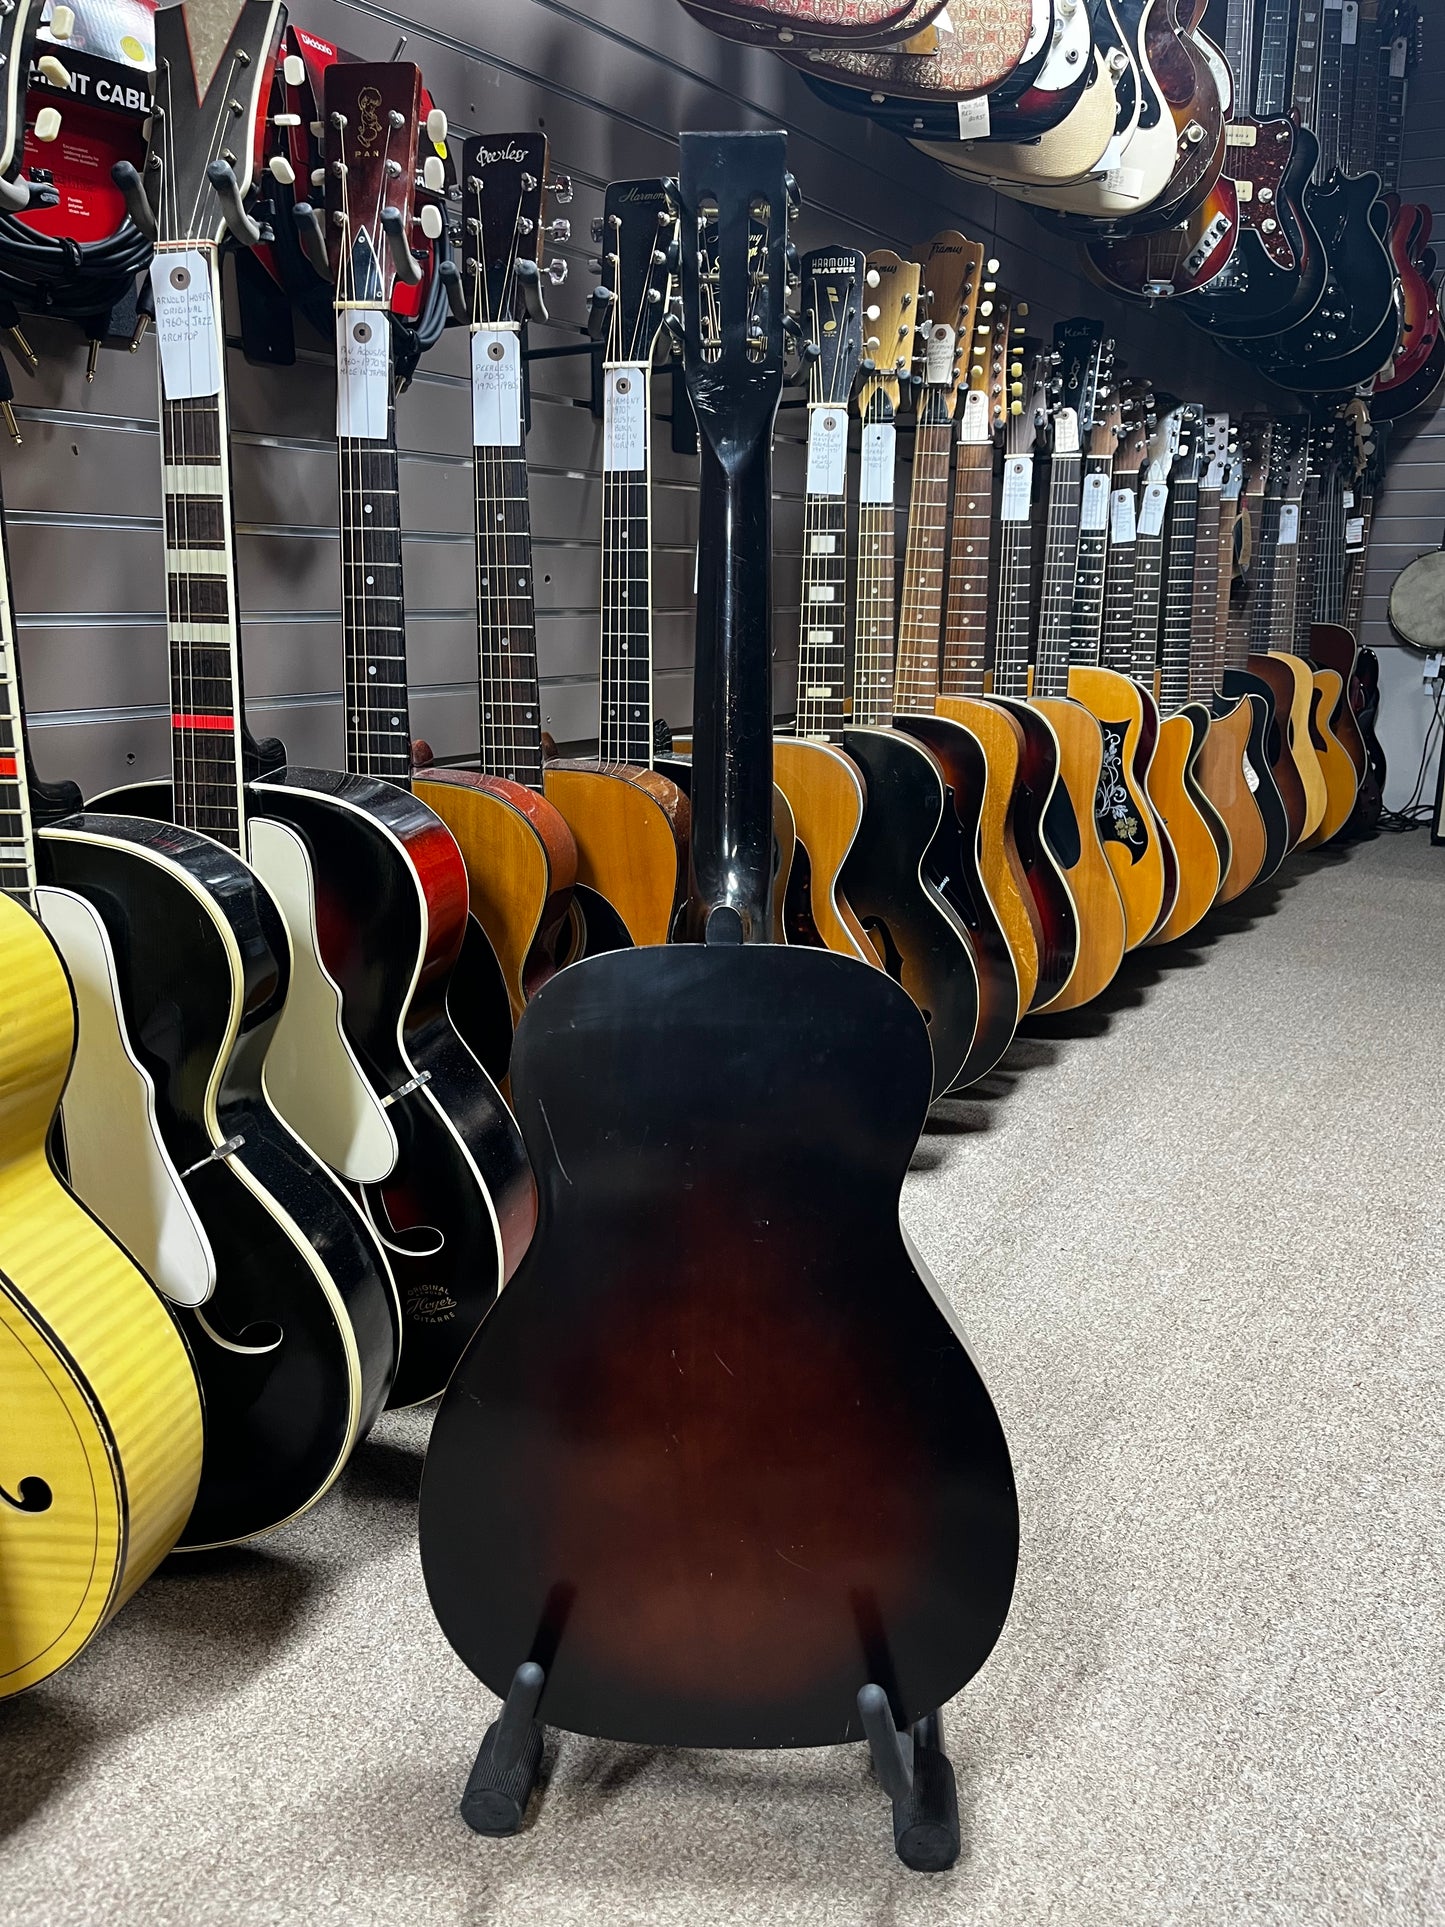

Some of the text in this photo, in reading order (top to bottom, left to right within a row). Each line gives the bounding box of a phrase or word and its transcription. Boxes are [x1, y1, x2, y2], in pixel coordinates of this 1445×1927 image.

[355, 150, 379, 158] PAN
[476, 140, 529, 167] Peerless
[812, 256, 856, 268] HARMONY
[812, 267, 856, 275] MASTER
[156, 295, 186, 305] ARNOLD
